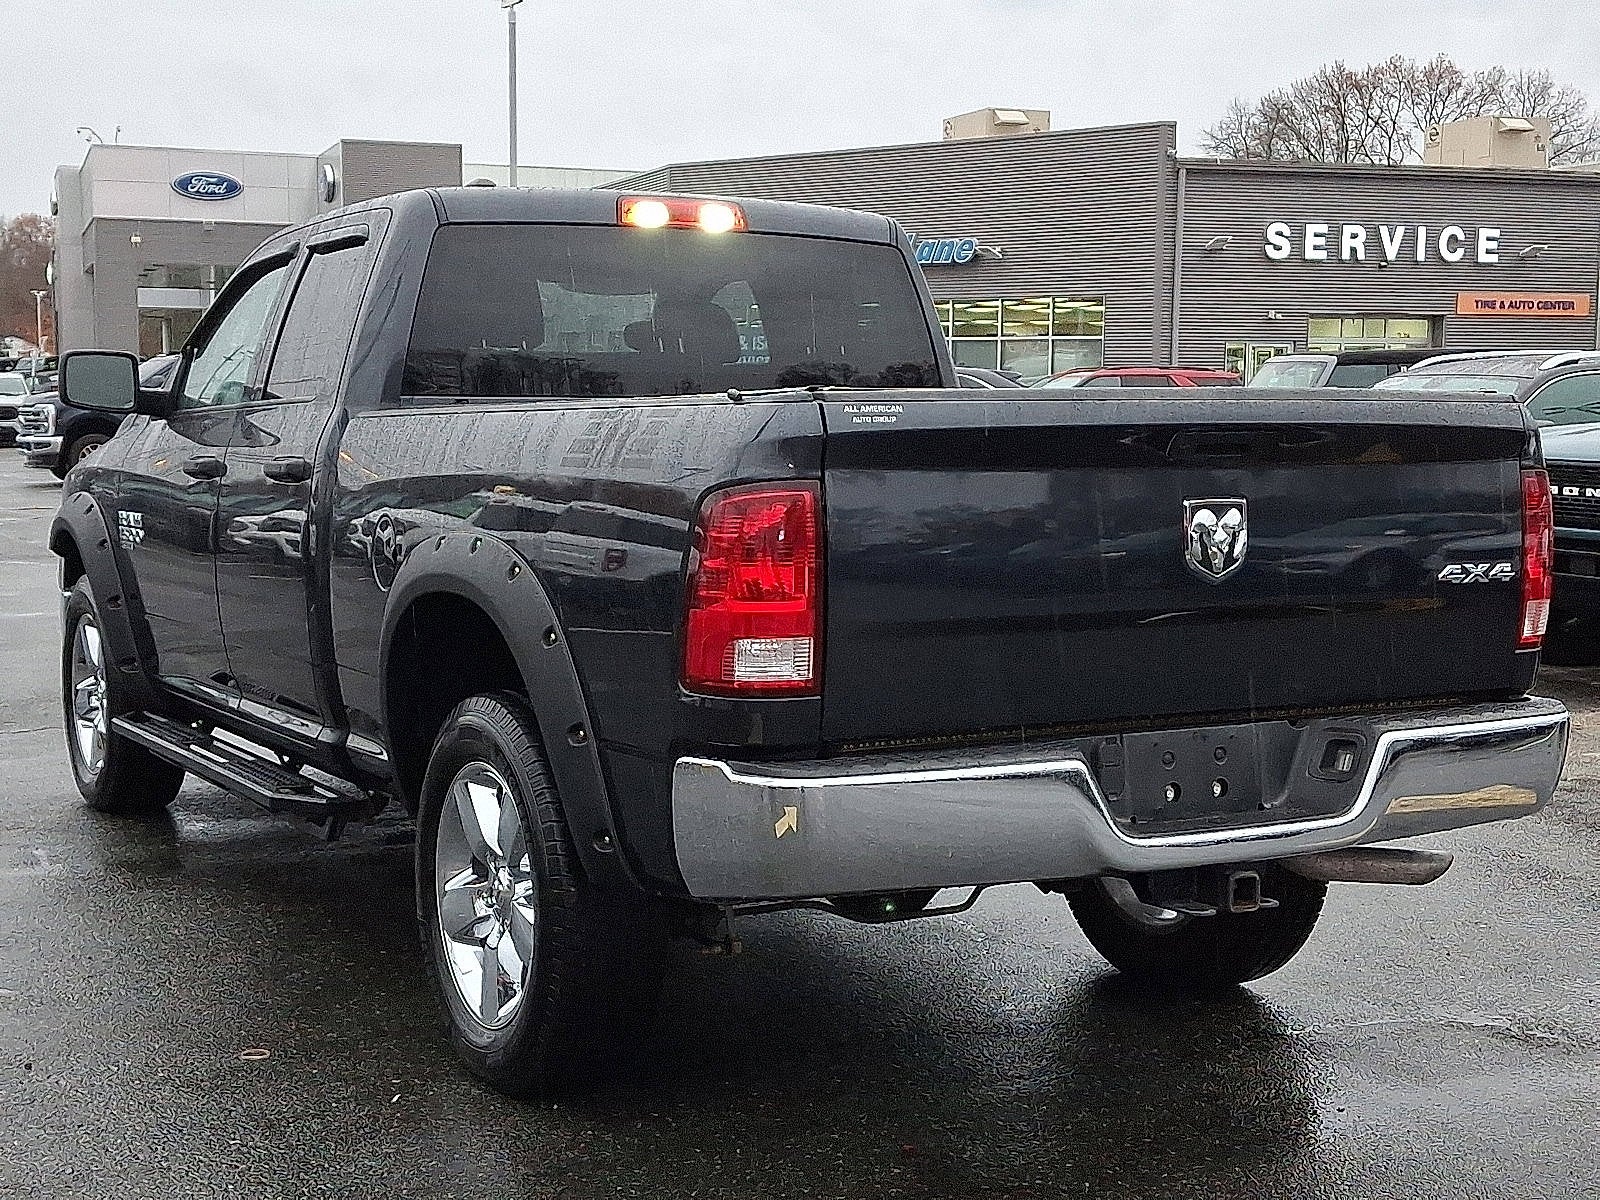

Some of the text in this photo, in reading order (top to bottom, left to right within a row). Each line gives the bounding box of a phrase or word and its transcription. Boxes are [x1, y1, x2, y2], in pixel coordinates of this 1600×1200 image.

[187, 176, 228, 194] Ford
[1263, 221, 1501, 263] SERVICE
[1474, 299, 1576, 311] TIRE & AUTO CENTER
[843, 404, 904, 413] ALL AMERICAN
[852, 415, 872, 423] AUTO
